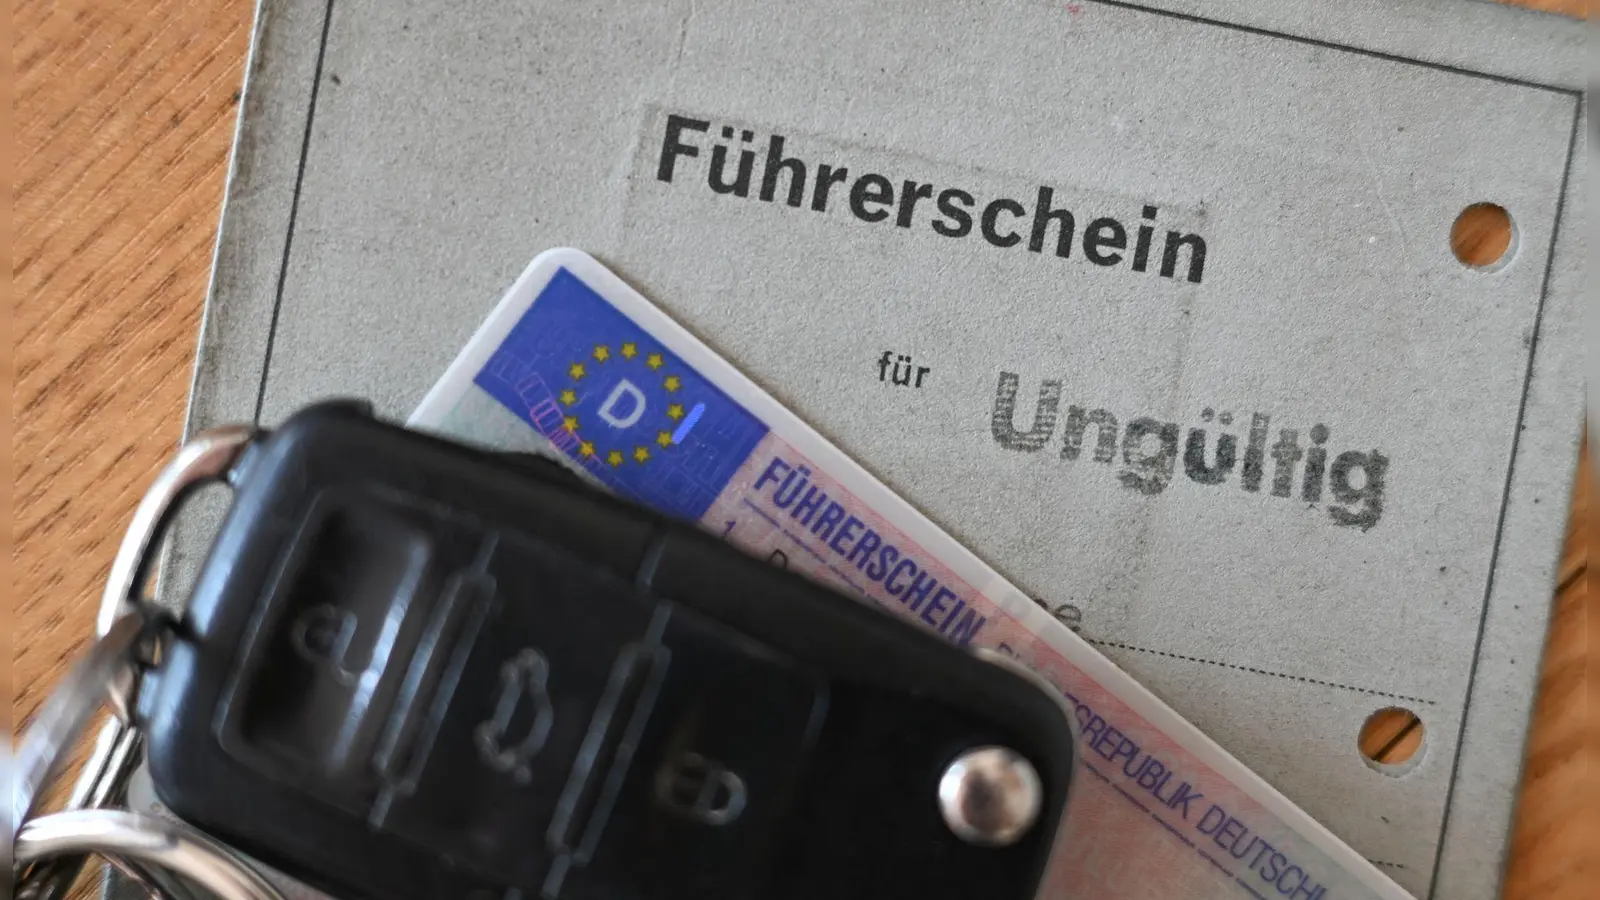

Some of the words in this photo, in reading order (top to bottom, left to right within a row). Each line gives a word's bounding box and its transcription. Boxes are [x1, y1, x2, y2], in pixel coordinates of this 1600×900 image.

[656, 113, 1208, 284] Führerschein
[597, 377, 647, 429] D
[877, 350, 932, 389] für
[991, 370, 1390, 533] Ungültig
[753, 456, 987, 647] FÜHRERSCHEIN
